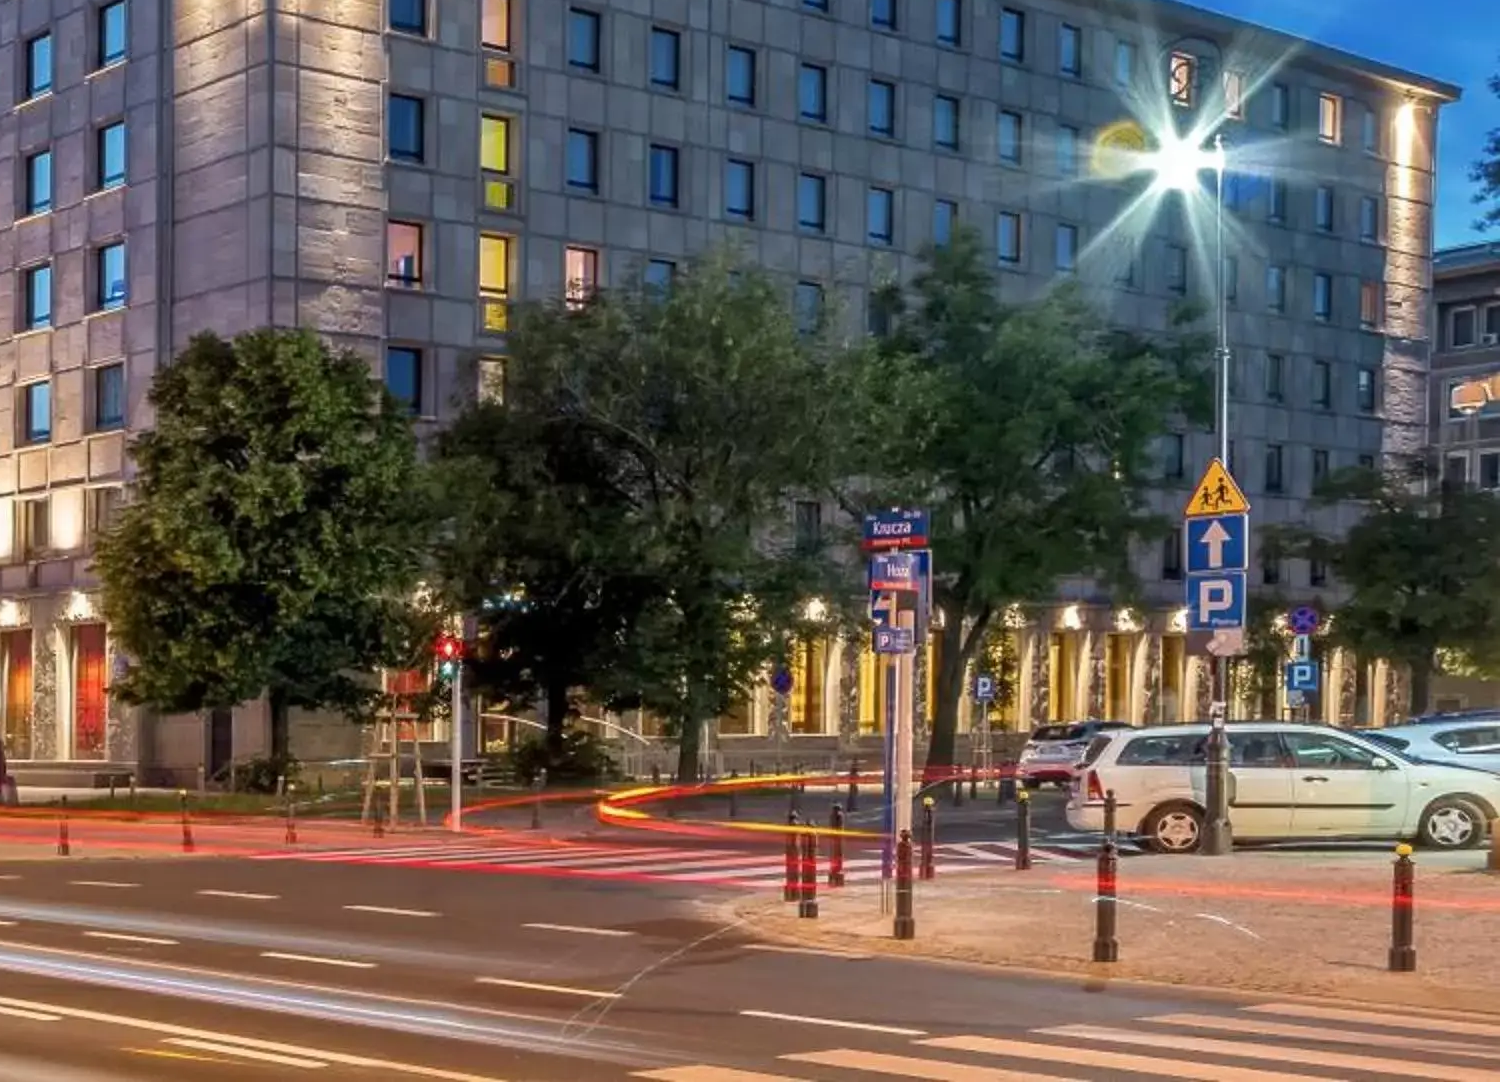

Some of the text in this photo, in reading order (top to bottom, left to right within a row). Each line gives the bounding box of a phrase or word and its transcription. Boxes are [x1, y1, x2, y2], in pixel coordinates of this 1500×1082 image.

[1199, 579, 1233, 623] P
[880, 635, 889, 647] P
[977, 677, 991, 697] P
[1293, 665, 1311, 688] P
